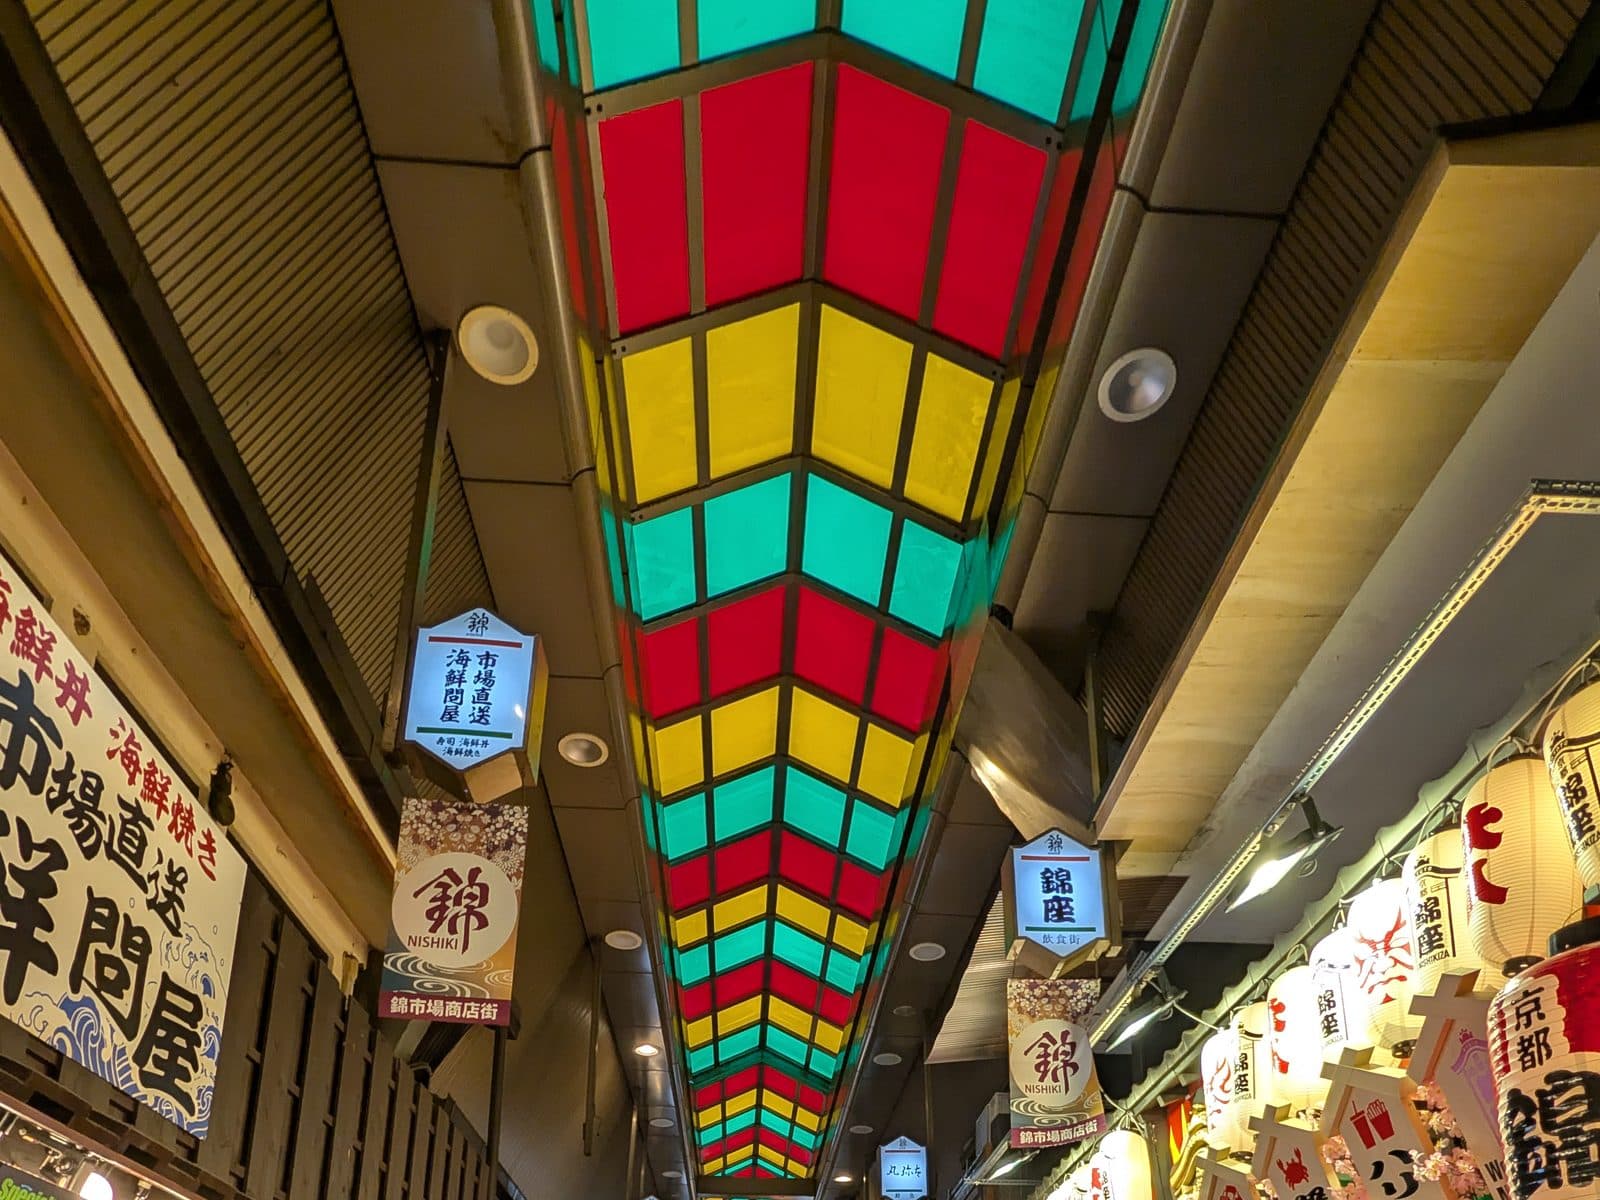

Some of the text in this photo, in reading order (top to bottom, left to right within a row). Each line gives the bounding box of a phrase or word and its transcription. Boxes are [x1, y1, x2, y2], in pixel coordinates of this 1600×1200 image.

[440, 649, 472, 723] 海鮮問屋
[468, 651, 499, 725] 市場直送
[106, 717, 217, 881] 海鮮焼き
[413, 867, 489, 955] 錦
[1040, 867, 1077, 923] 錦座
[407, 935, 458, 951] NISHIKI
[390, 996, 498, 1020] 錦市場商店街
[1512, 986, 1552, 1073] 京都
[1024, 1030, 1080, 1095] 錦
[1025, 1084, 1061, 1094] NISHIKI
[1020, 1120, 1098, 1145] 錦市場商店街
